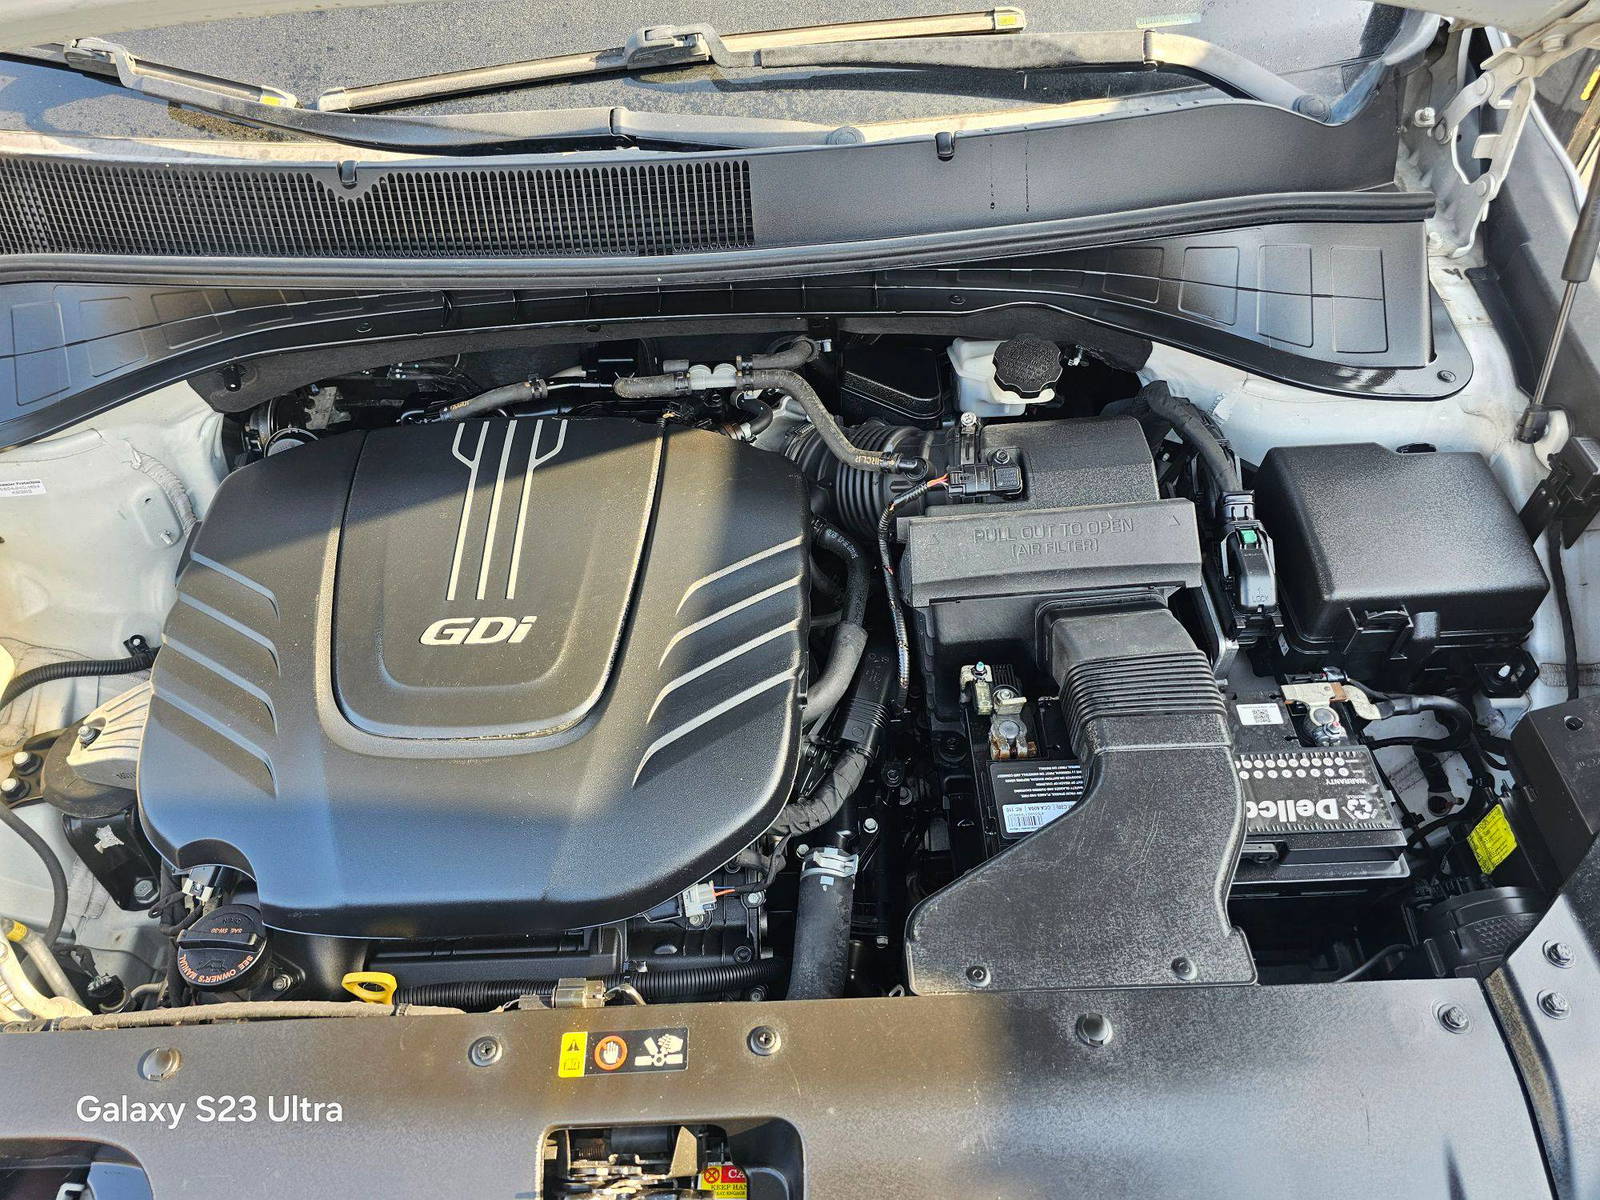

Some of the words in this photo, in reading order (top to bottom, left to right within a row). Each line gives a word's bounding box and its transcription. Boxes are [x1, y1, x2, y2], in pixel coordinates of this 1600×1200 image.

[972, 526, 1017, 543] PULL
[1020, 524, 1055, 540] OUT
[1059, 521, 1082, 537] TO
[1087, 517, 1135, 534] OPEN
[1012, 541, 1043, 557] (AIR
[1045, 537, 1099, 555] FILTER)
[419, 615, 538, 646] GDi
[1326, 778, 1368, 786] WARRANTY
[178, 953, 199, 980] MANUAL
[237, 955, 254, 971] SEE
[197, 968, 237, 983] OWNER'S
